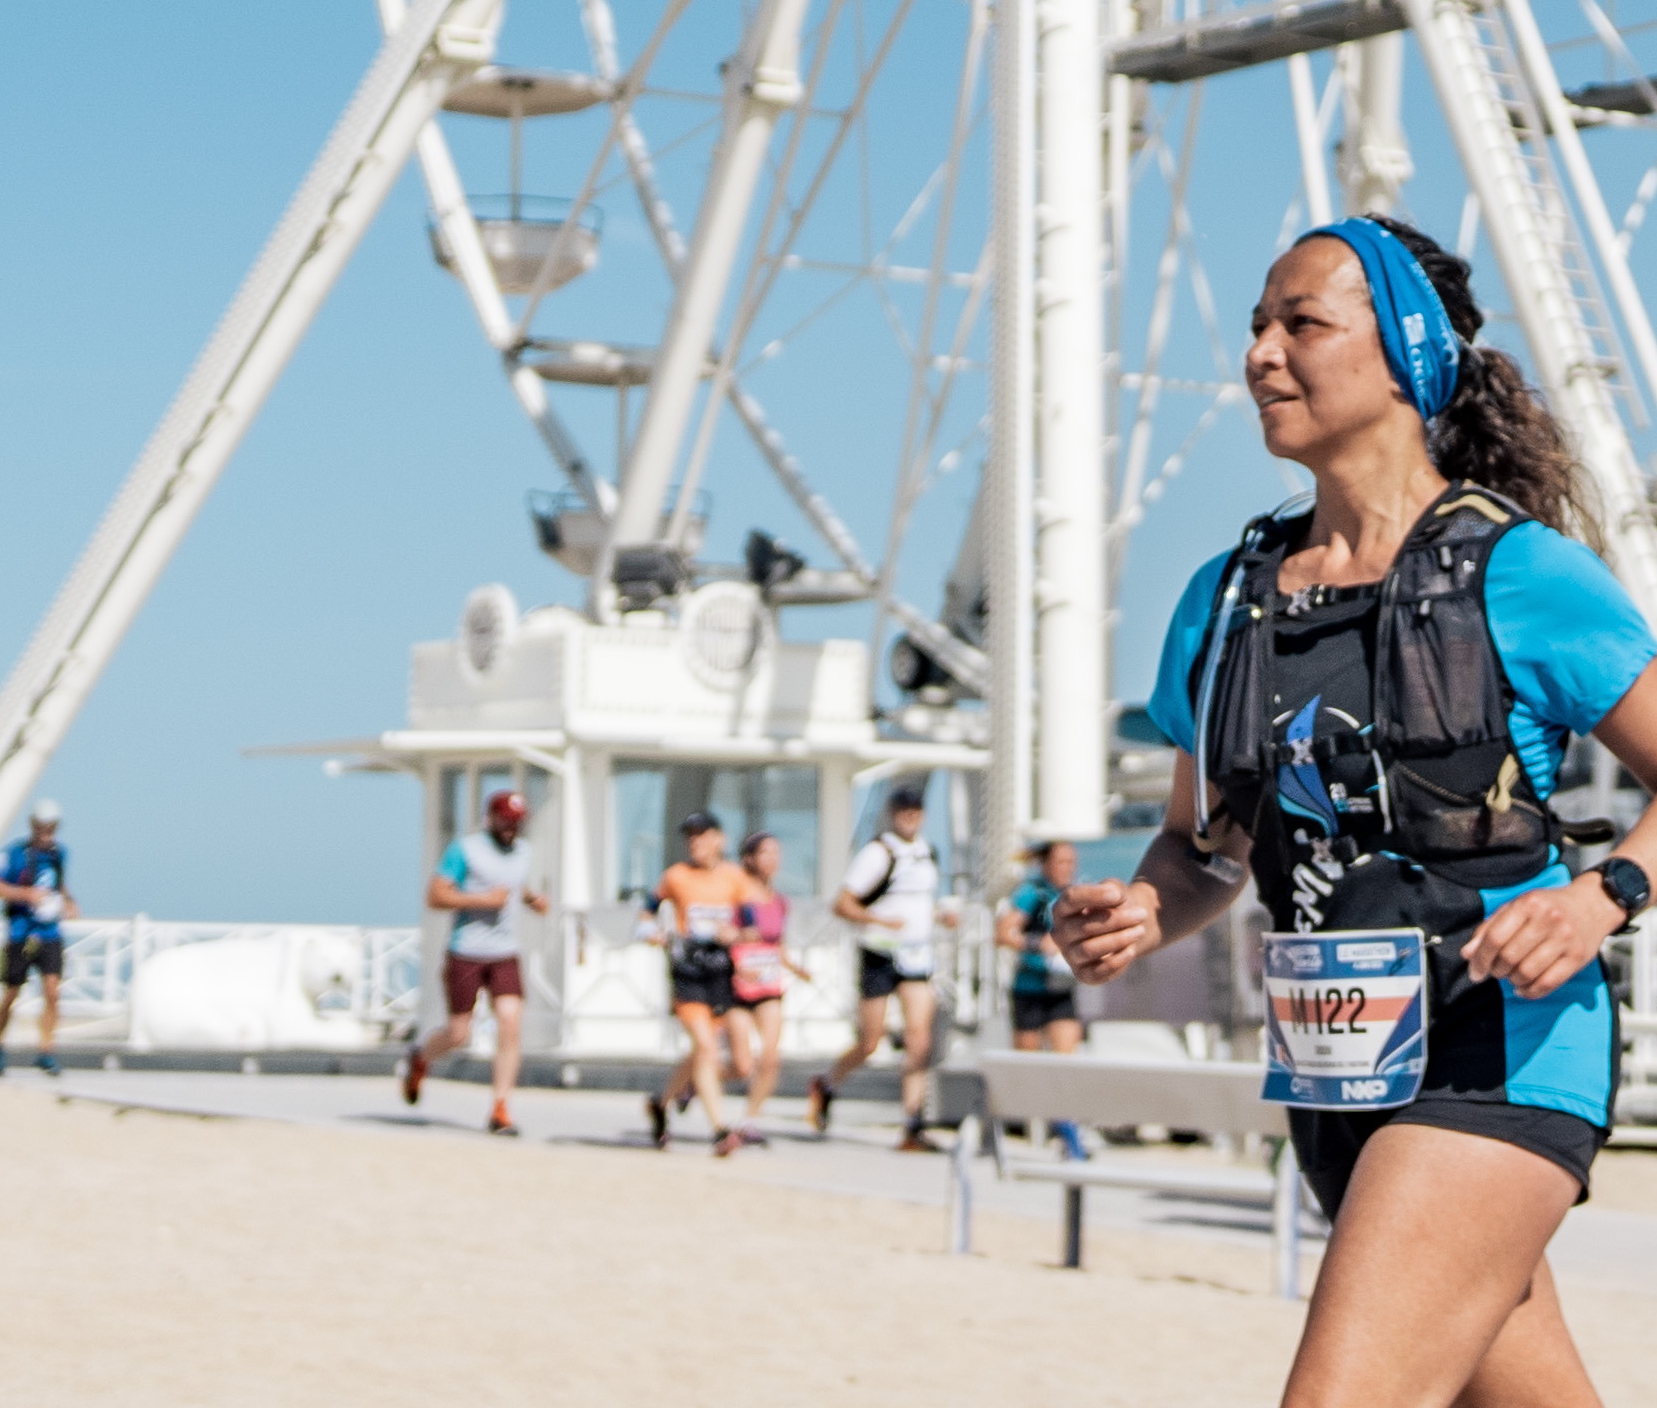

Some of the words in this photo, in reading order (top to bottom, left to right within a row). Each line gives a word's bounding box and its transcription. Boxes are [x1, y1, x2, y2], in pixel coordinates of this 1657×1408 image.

[1290, 988, 1309, 1035] M
[1316, 987, 1367, 1035] 122
[1341, 1080, 1387, 1101] NXP
